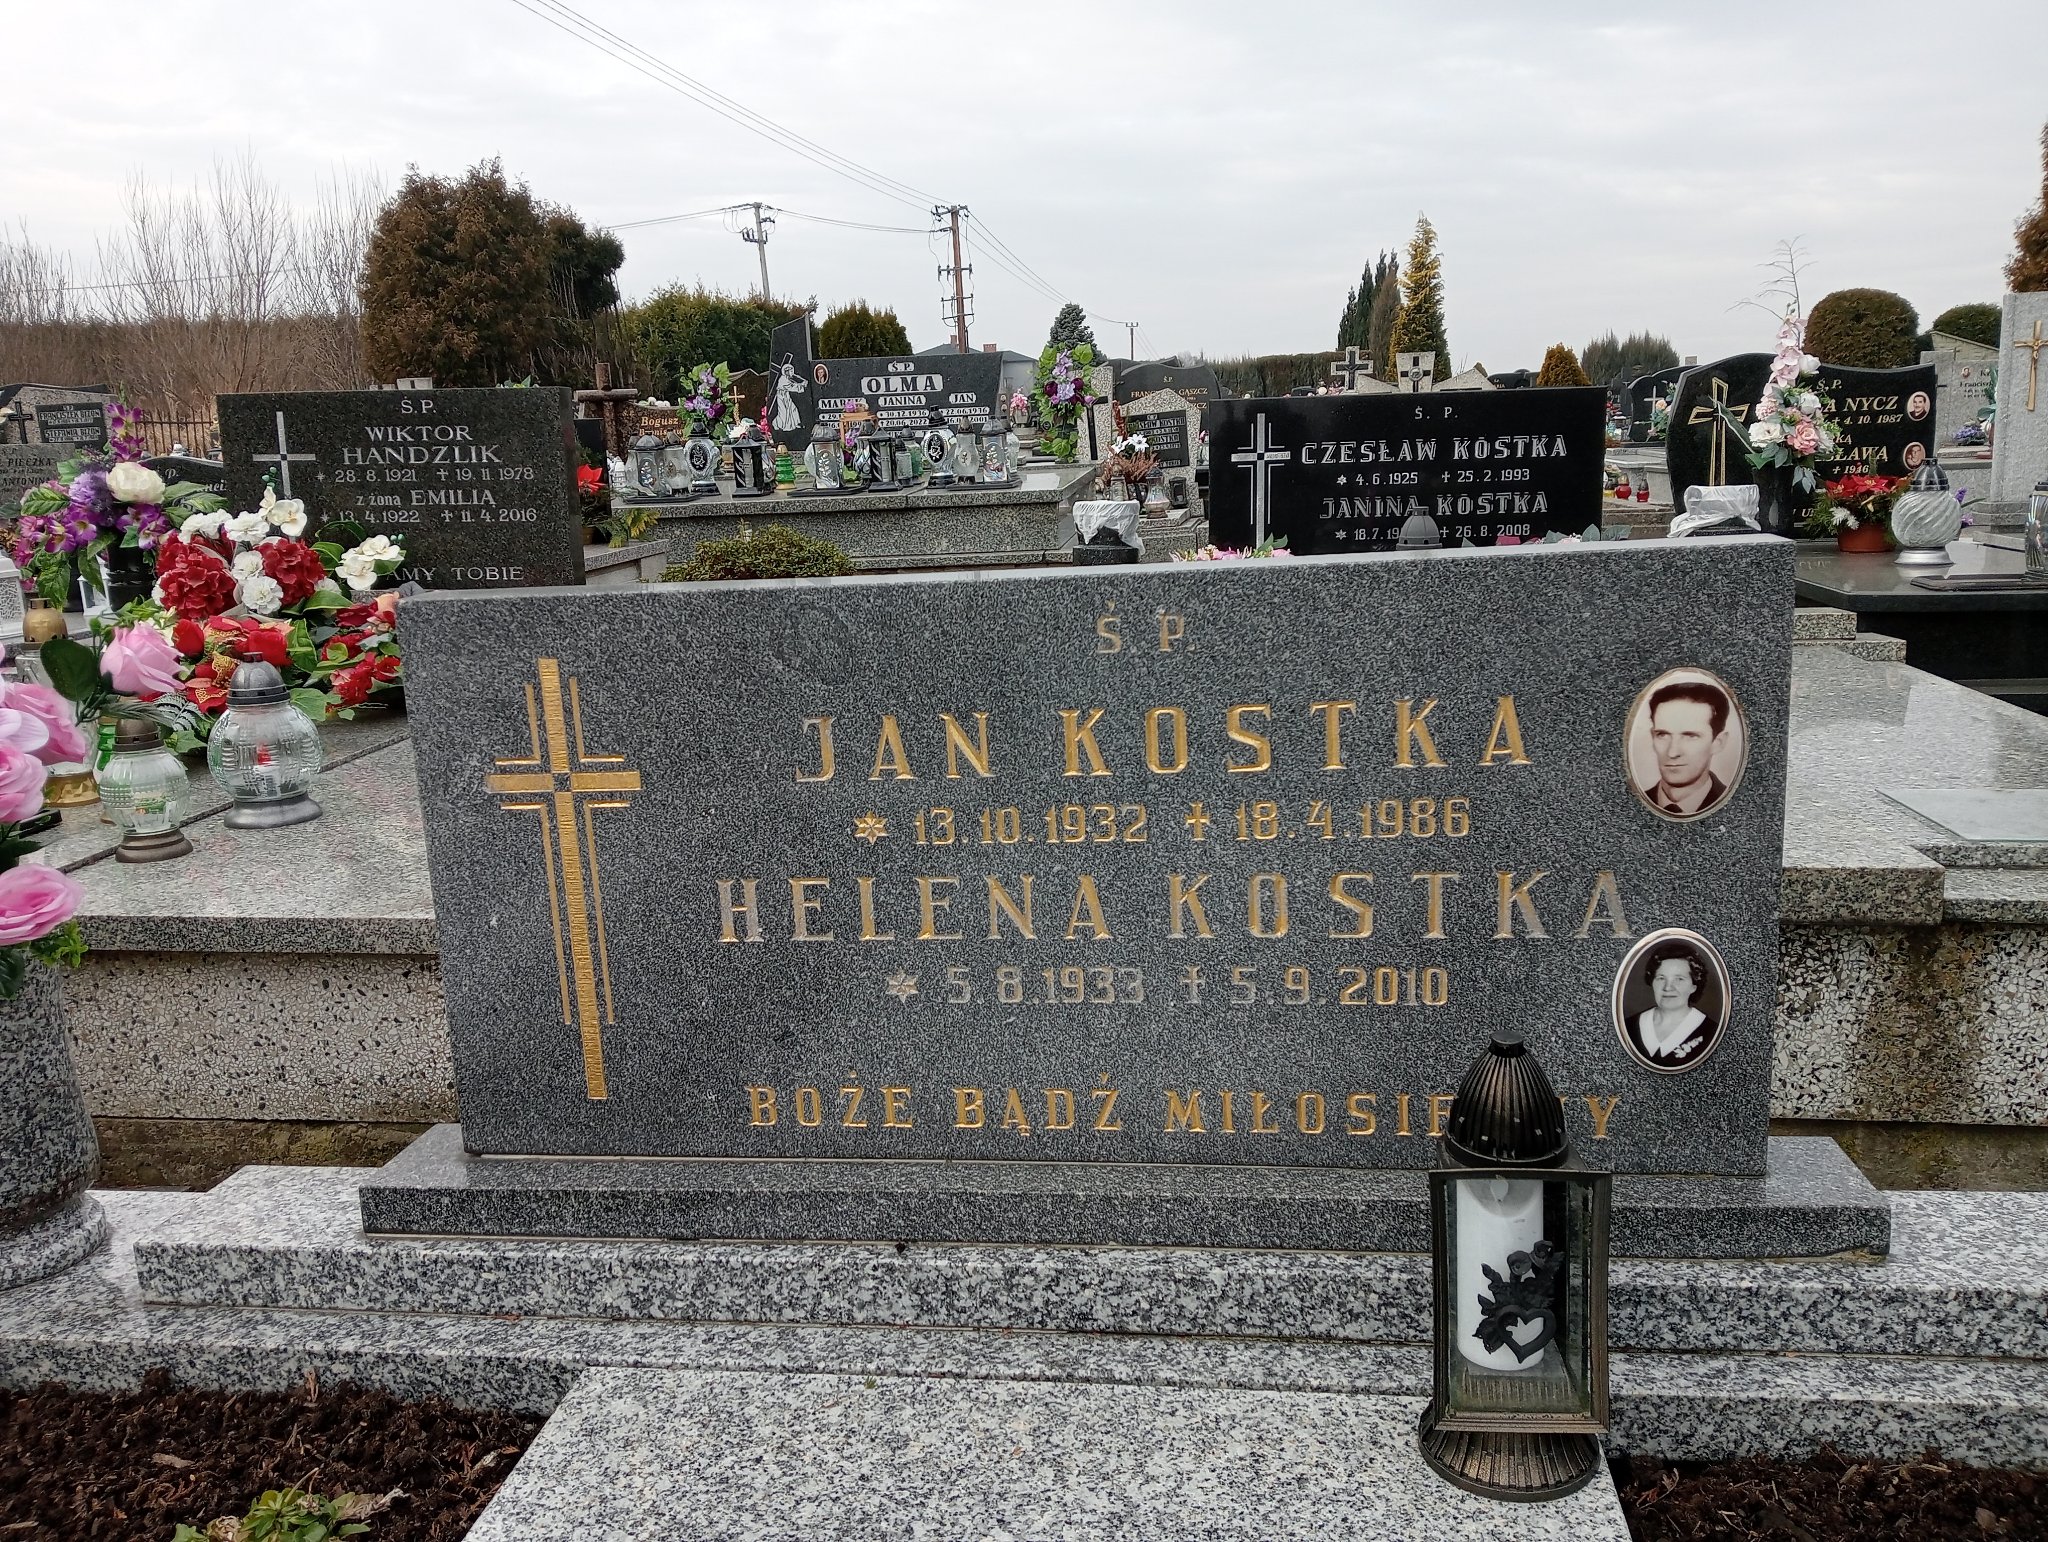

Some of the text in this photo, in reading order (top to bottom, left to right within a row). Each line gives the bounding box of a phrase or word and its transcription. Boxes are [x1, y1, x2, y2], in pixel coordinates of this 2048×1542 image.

[866, 376, 938, 393] OLMA
[883, 396, 923, 406] JANINA
[954, 394, 974, 403] JAN
[1843, 396, 1898, 412] NYCZ
[640, 416, 679, 428] Bogusz
[1877, 414, 1904, 424] 1987
[365, 425, 473, 443] WIKTOR
[342, 445, 503, 465] HANDZLIK
[1301, 434, 1568, 465] CZESŁAW KOSTKA
[385, 468, 417, 482] 1921
[499, 467, 534, 481] 1978
[355, 489, 497, 508] z żoną EMILIĄ
[1319, 491, 1548, 520] JANINA KOSTKA
[499, 508, 537, 522] 2016
[451, 566, 524, 581] TOBIE
[796, 695, 1533, 783] JAN KOSTKA
[716, 869, 1634, 944] HELENA KOSTKA
[744, 1070, 915, 1129] BOŻE
[952, 1072, 1122, 1138] BĄDŹ
